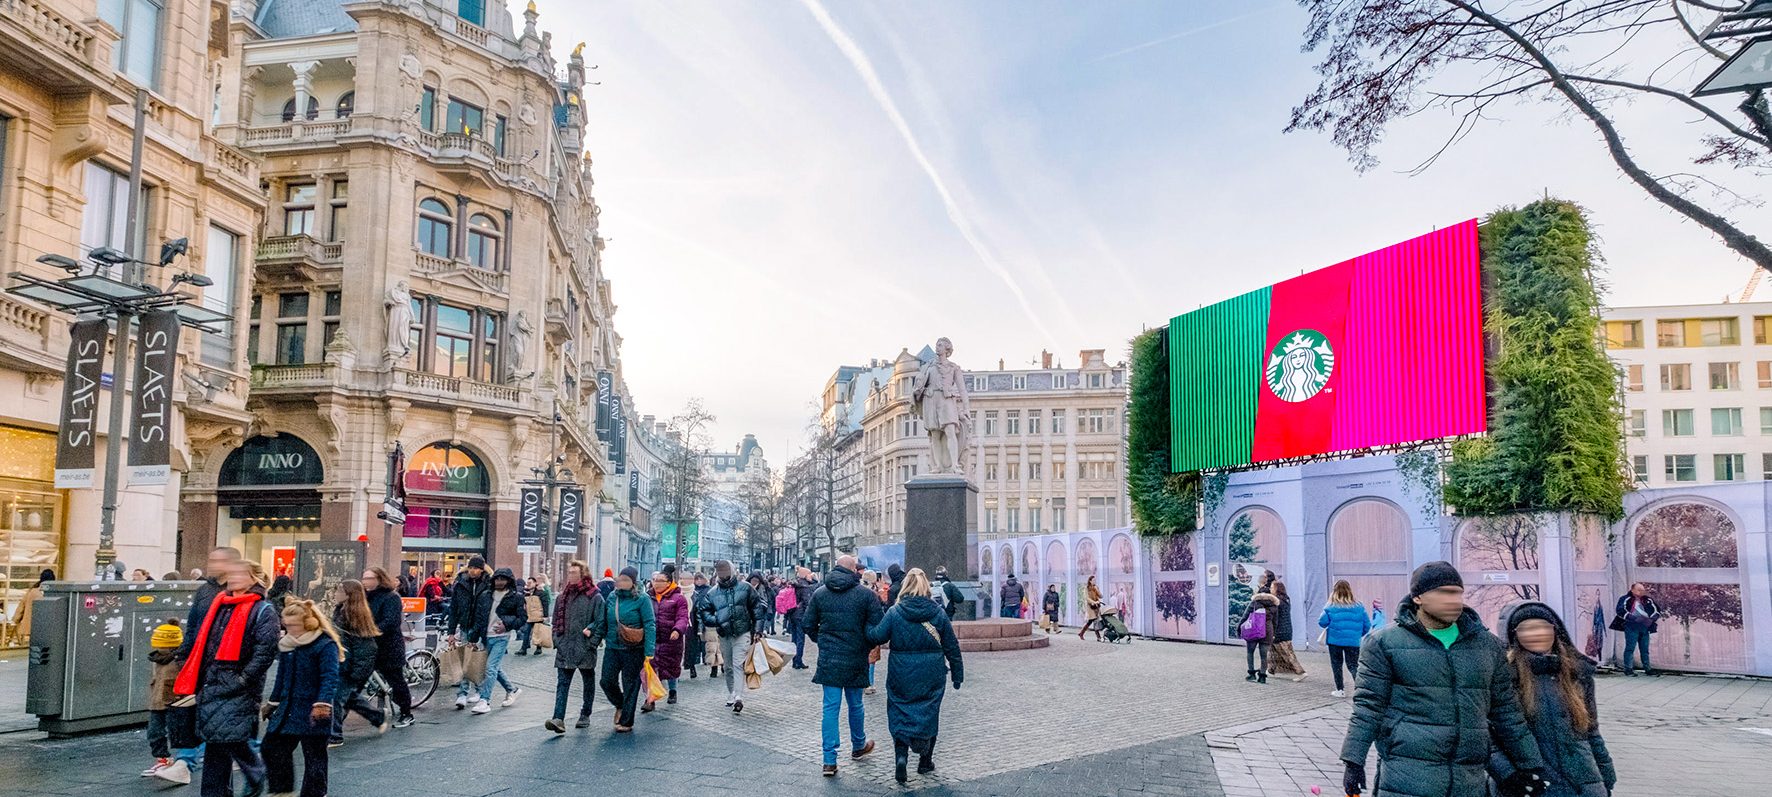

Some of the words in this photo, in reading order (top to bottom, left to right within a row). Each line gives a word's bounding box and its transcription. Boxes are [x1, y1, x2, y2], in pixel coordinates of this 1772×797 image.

[69, 340, 98, 446] SLAETS
[141, 331, 167, 442] SLAETS
[599, 377, 610, 406] INNO
[611, 399, 619, 420] INNO
[258, 453, 303, 468] INNO
[420, 461, 469, 479] INNO
[523, 492, 539, 532] INNO
[561, 492, 577, 533] INNO
